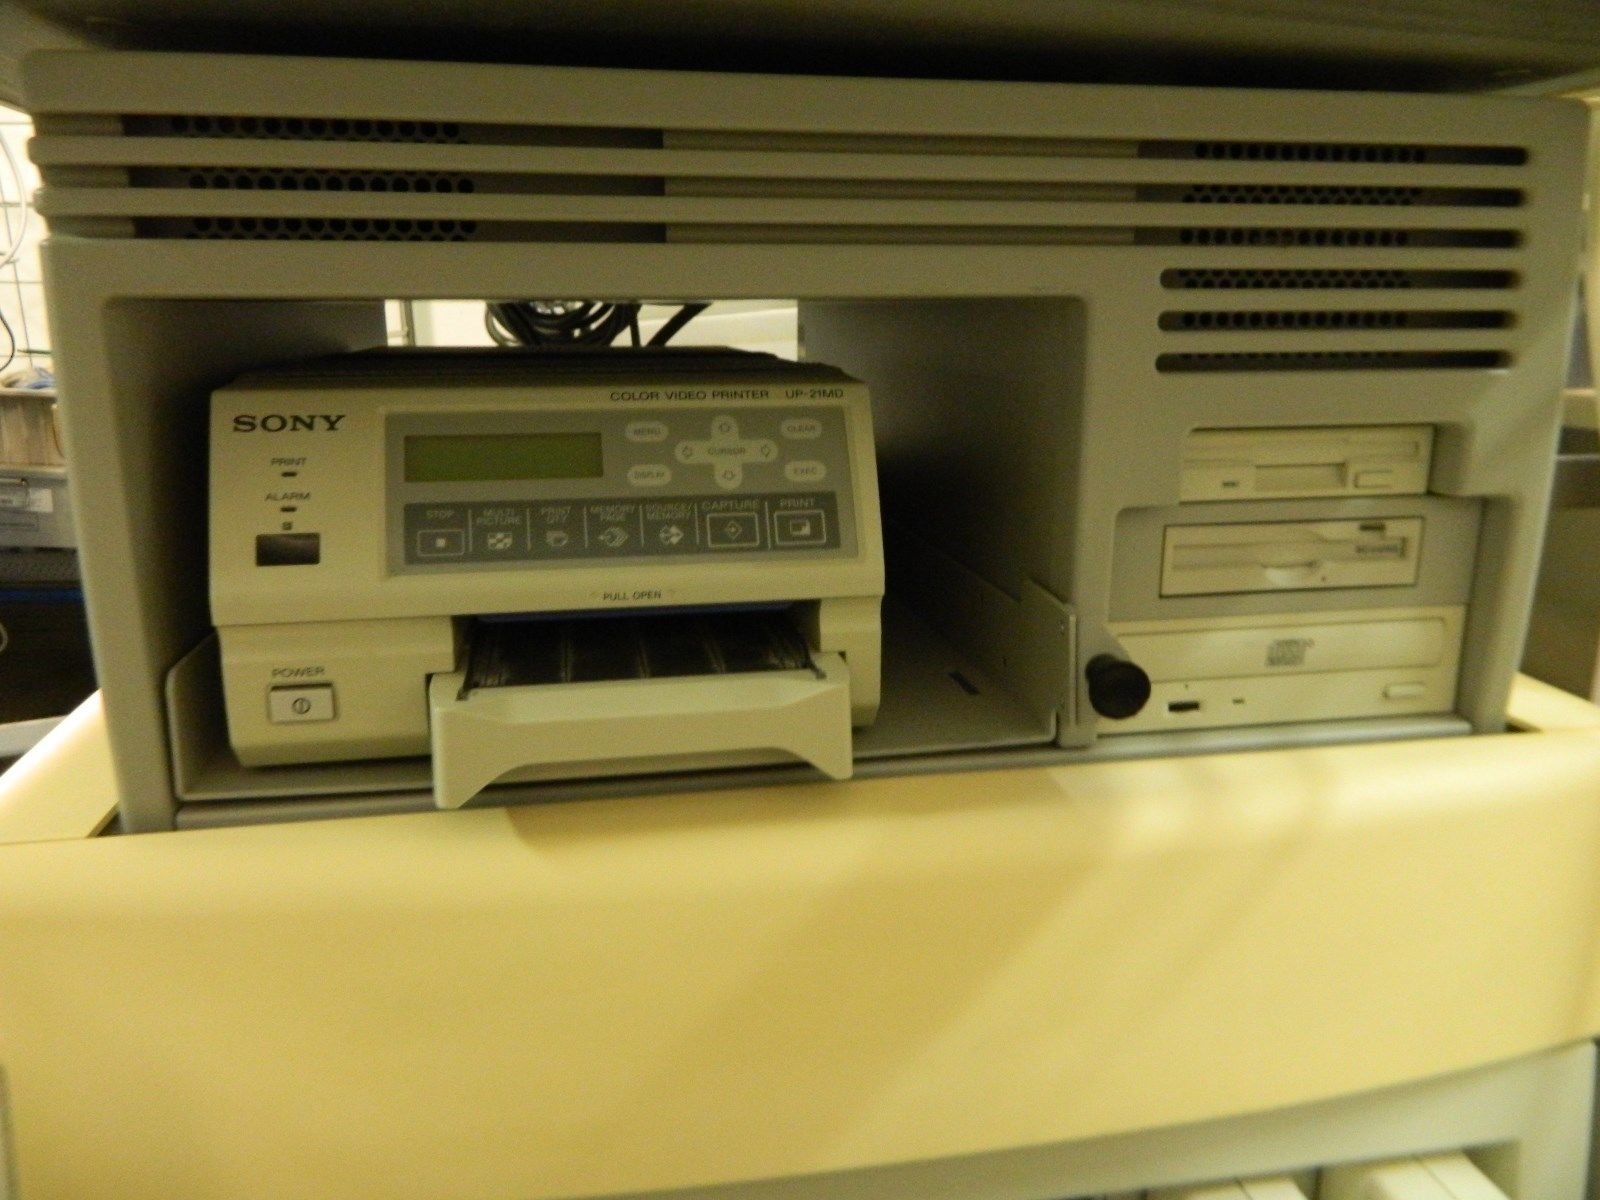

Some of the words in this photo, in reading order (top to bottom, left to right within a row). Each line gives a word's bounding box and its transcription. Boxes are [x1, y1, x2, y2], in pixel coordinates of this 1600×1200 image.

[610, 390, 660, 402] COLOR
[663, 389, 707, 401] VIDEO
[711, 388, 770, 400] PRINTER
[232, 414, 346, 433] SONY
[270, 457, 308, 467] PRINT
[264, 492, 312, 501] ALARM
[701, 499, 760, 511] CAPTURE
[779, 497, 816, 508] PRINT
[603, 591, 627, 601] PULL
[632, 590, 662, 600] OPEN
[272, 666, 325, 678] POWER
